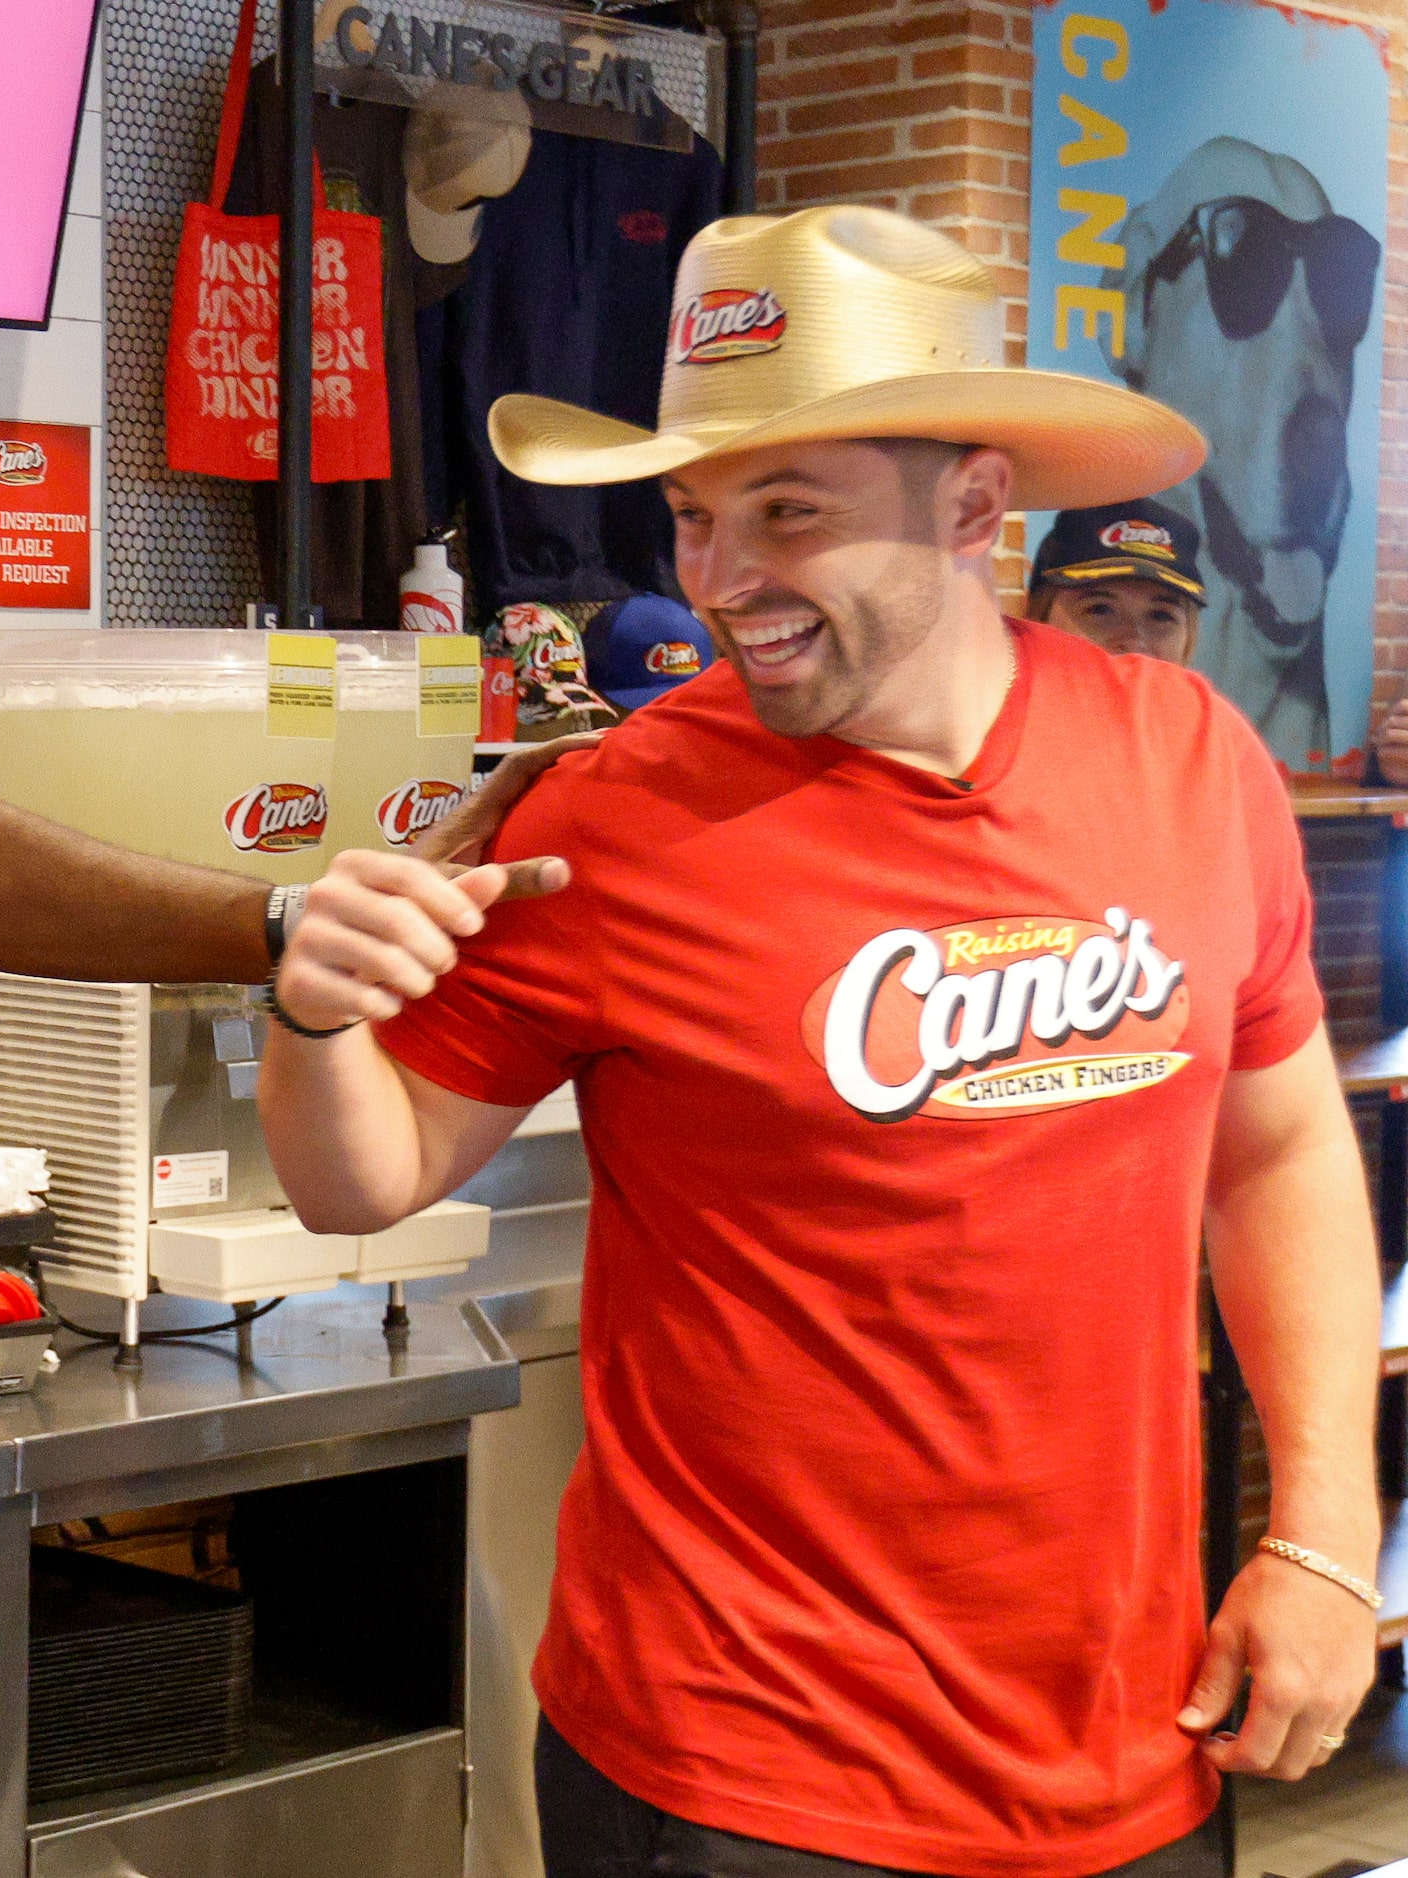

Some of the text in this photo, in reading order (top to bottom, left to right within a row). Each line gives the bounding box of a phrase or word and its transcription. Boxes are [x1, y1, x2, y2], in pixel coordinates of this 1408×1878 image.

[528, 41, 654, 117] GEAR
[1054, 14, 1129, 359] CANE
[672, 287, 786, 364] Cane's
[0, 511, 86, 533] INSPECTION
[2, 564, 70, 586] REQUEST
[944, 921, 1078, 968] Raising
[824, 907, 1184, 1118] Cane's
[964, 1057, 1168, 1102] CHICKEN FINGERS
